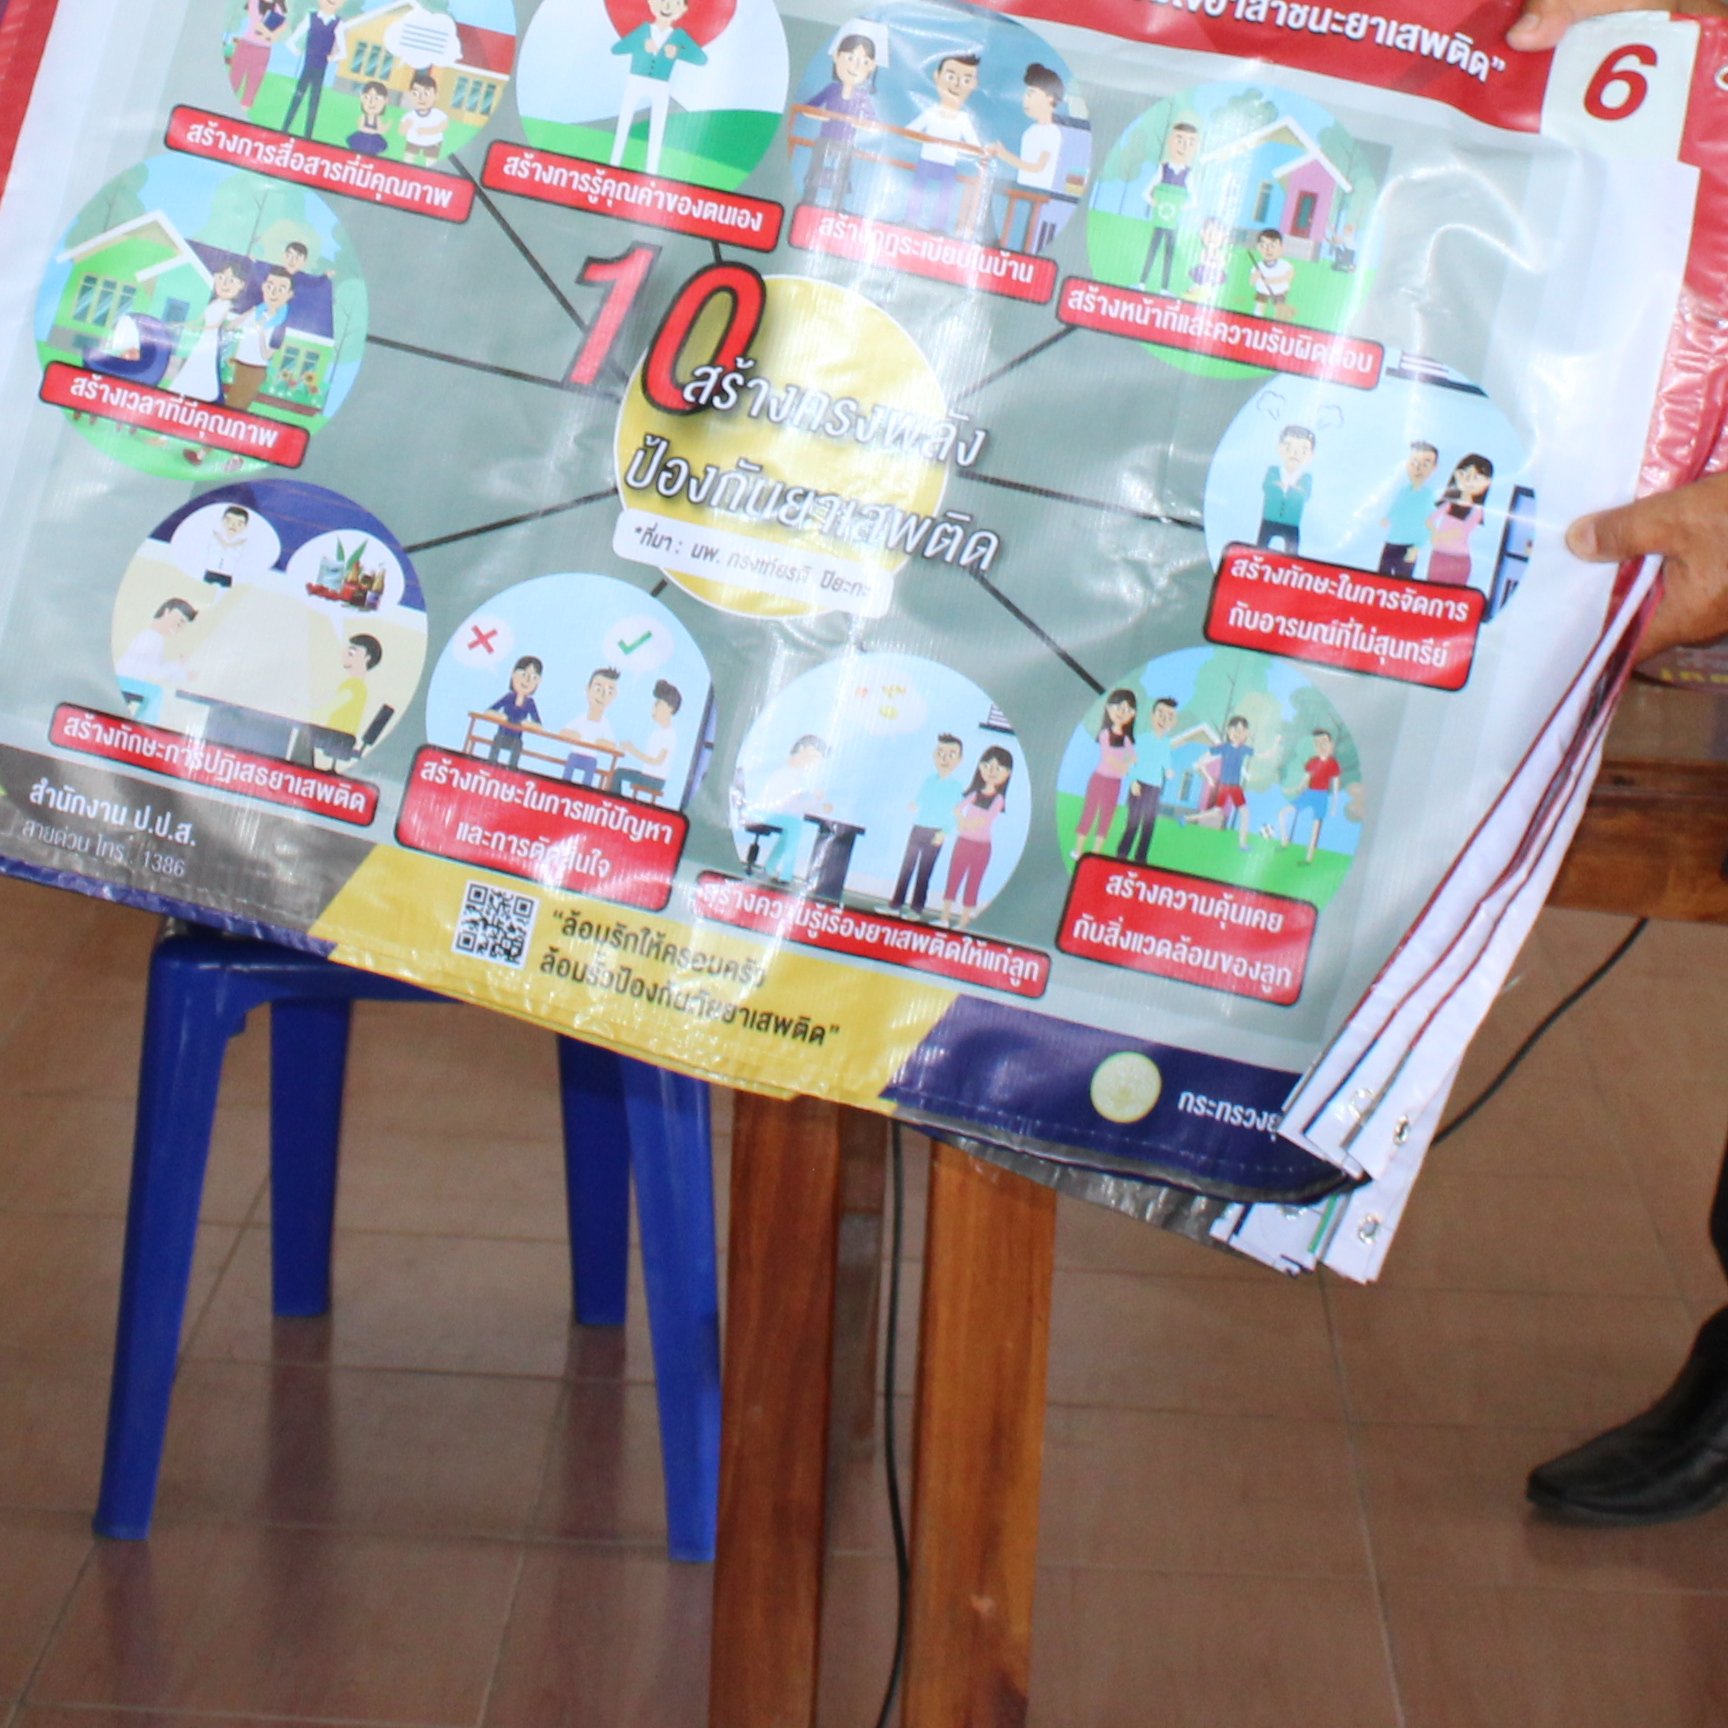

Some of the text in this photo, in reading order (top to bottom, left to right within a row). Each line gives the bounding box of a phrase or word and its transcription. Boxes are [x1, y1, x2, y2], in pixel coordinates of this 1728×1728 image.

[1582, 43, 1659, 122] 6
[186, 121, 453, 208] สร้างการสื่อสารที่มีคุณภาพ
[503, 153, 764, 232] สร้างการรู้คุณค่าของตนเอง
[564, 242, 766, 415] 10
[70, 374, 278, 448] สร้างเวลาที่มีคุณภาพ
[624, 433, 1001, 572] ป้องกันยาเสพติด
[1230, 556, 1470, 622] สร้างทักษะในการจัดการ
[1228, 601, 1450, 668] กับอารมณ์ที่ไม่สุนทรีย์
[63, 713, 367, 813] สร้างทักษะการปฏิเสธยาเสพติด
[420, 758, 673, 844] สร้างทักษะในการแก้ปัญหา
[22, 819, 90, 854] สายด่วน
[142, 850, 185, 877] 1386
[29, 777, 197, 847] สำนักงาน ป.ป.ส.
[1105, 871, 1284, 932] สร้างความคุ้นเคย
[1073, 913, 1292, 993] กับสิ่งแวดล้อมของลูก
